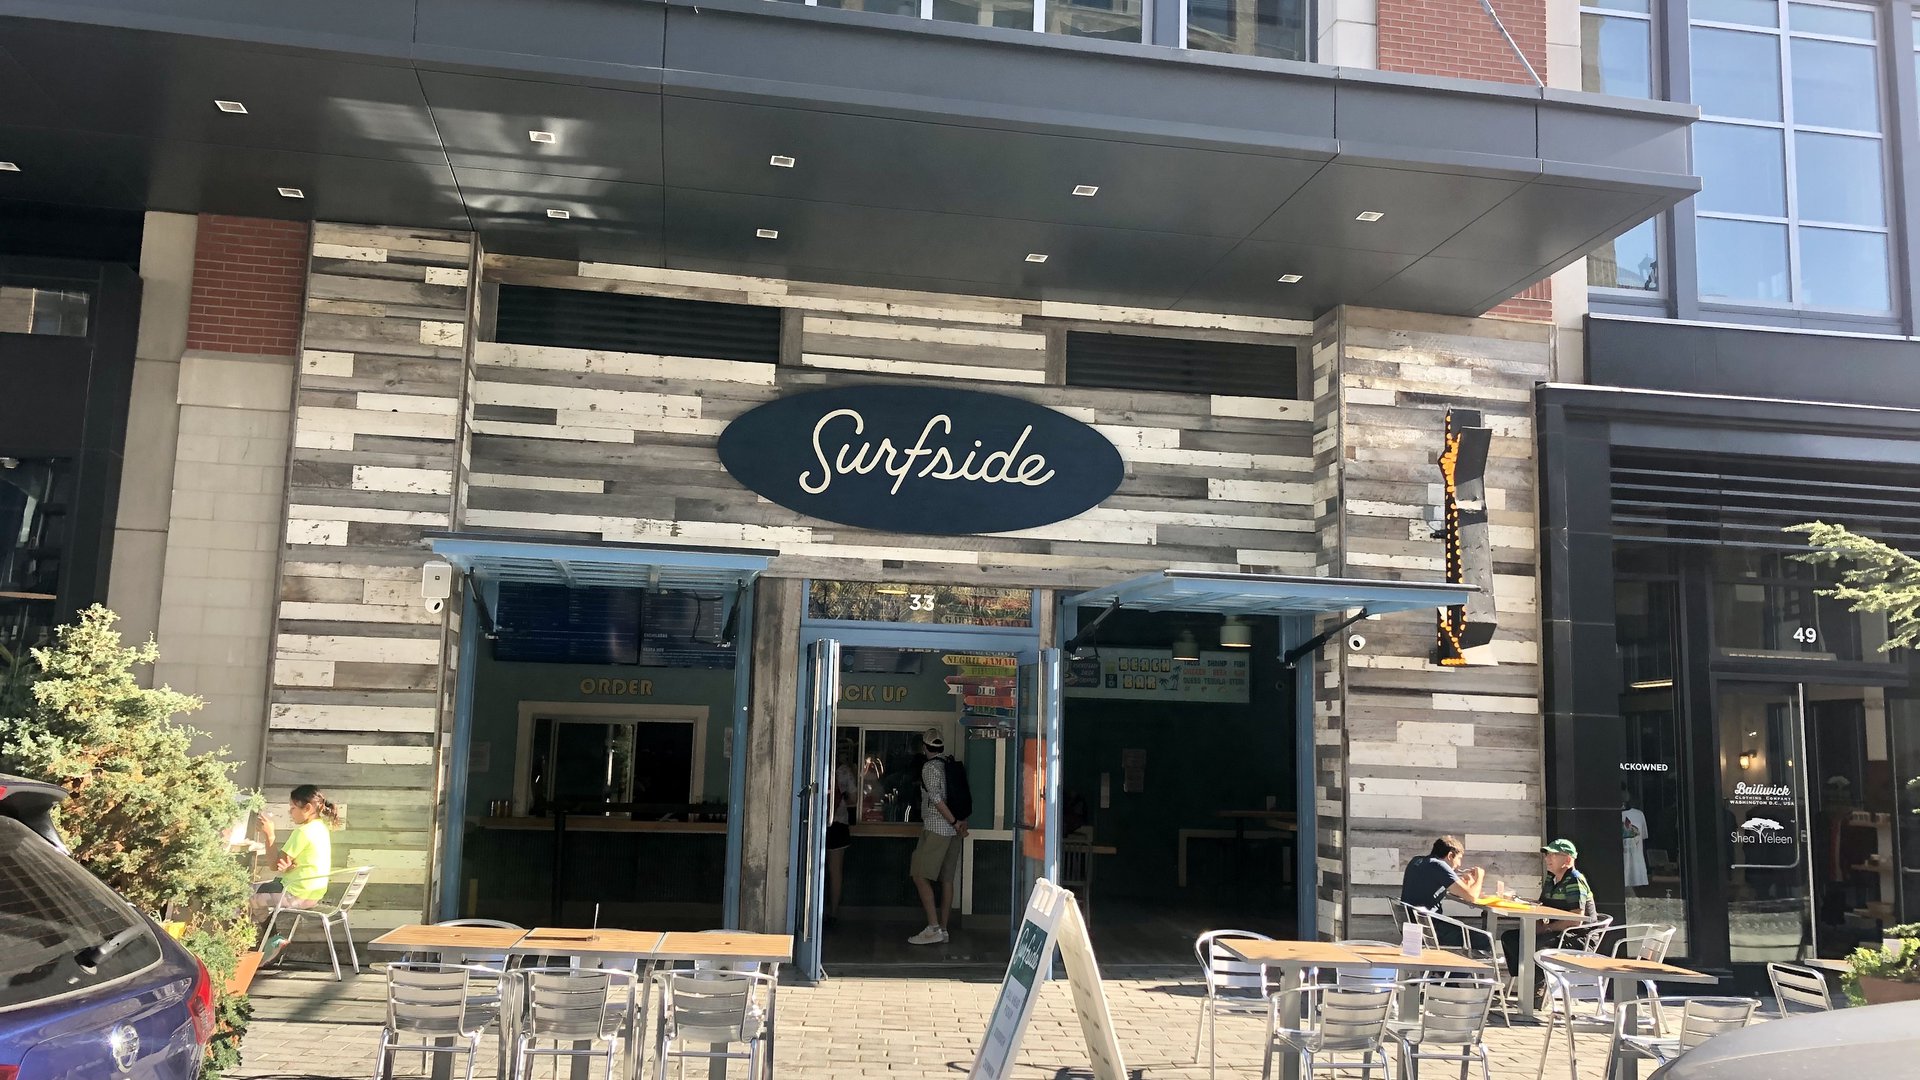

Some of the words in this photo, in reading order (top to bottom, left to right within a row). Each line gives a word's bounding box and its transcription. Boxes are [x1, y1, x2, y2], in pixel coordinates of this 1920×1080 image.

[799, 408, 1055, 495] Surfside
[909, 594, 935, 611] 33
[1793, 627, 1817, 643] 49
[947, 655, 980, 664] NEGRIL
[983, 657, 1016, 666] JAMAI
[1118, 657, 1171, 672] BEACH
[580, 678, 655, 696] ORDER
[1123, 674, 1157, 689] BAR
[838, 684, 876, 702] ICK
[881, 685, 908, 702] UP
[1619, 762, 1669, 772] ACKOWNED
[1734, 781, 1791, 796] Bailiwick
[1730, 831, 1755, 844] Shea
[1761, 831, 1793, 844] Yeleen
